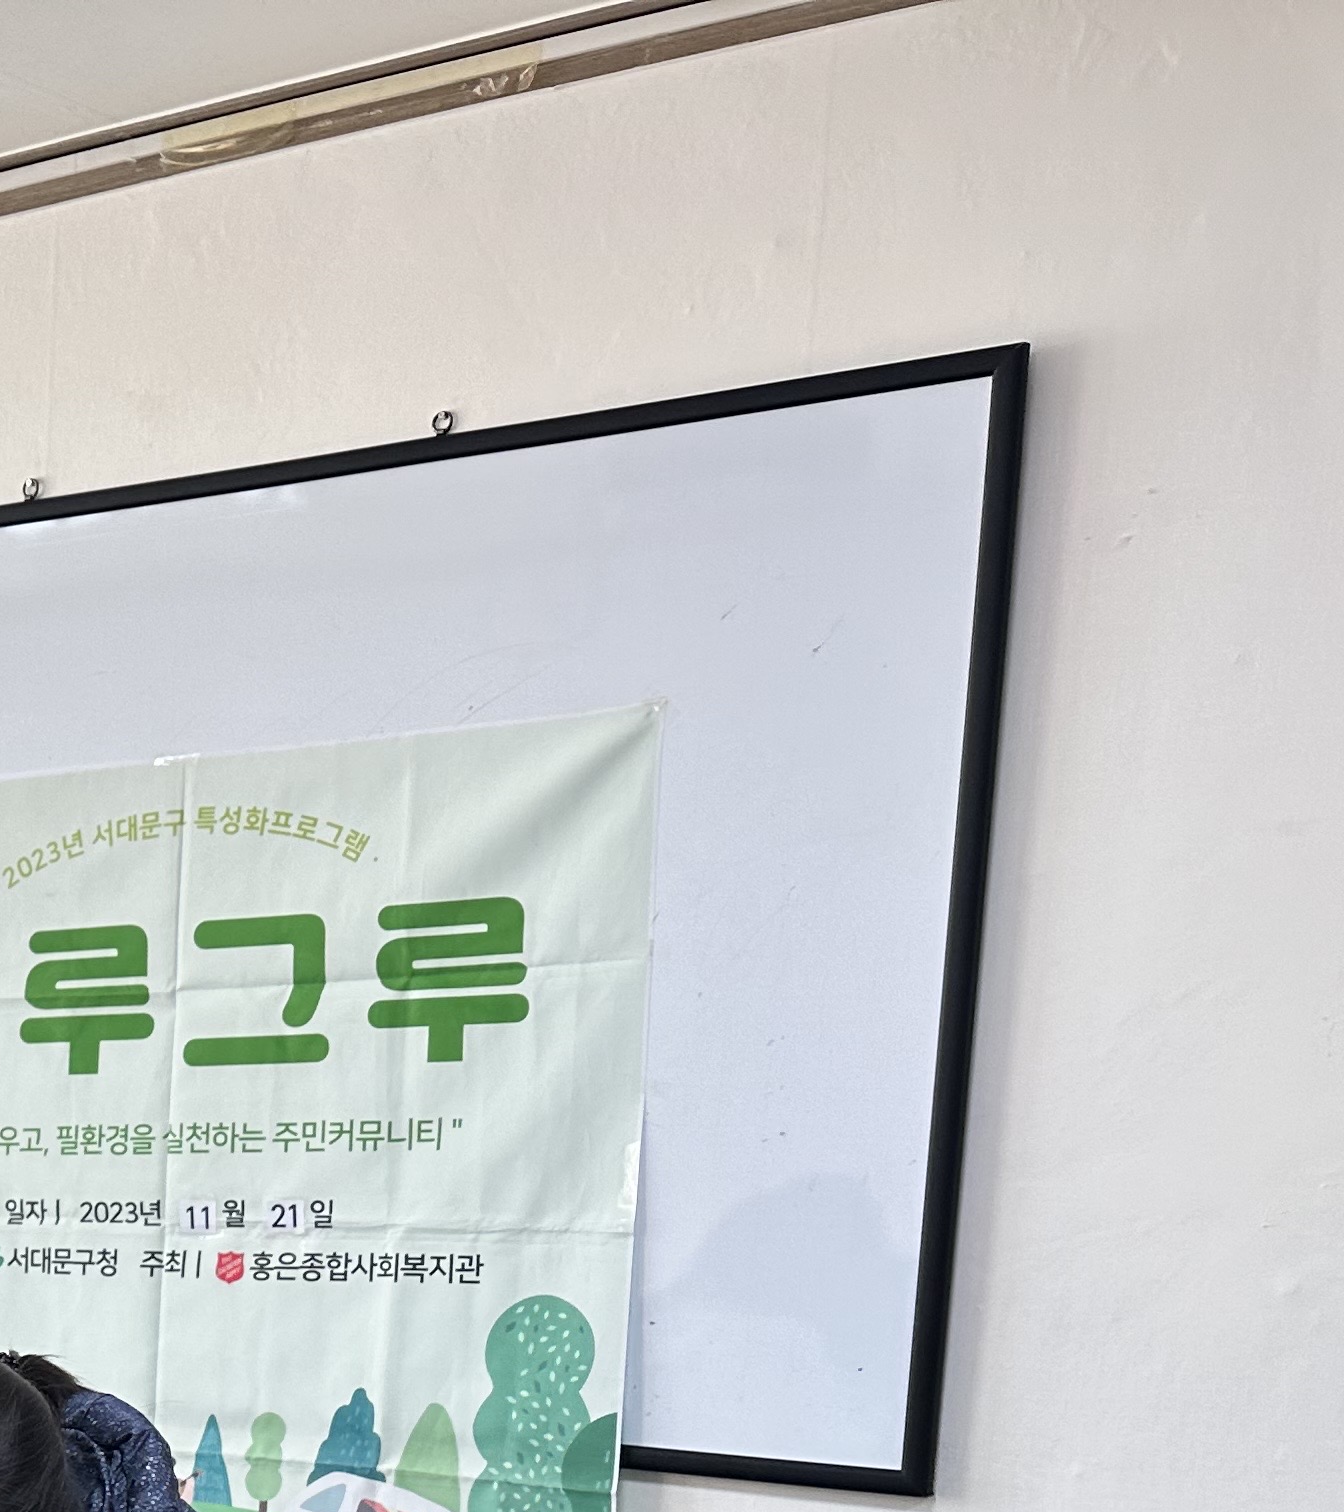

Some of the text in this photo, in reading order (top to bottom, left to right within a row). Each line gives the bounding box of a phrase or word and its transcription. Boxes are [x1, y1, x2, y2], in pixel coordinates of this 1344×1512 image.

[2, 805, 371, 889] 2023년 서대문구 특성화프로그램
[56, 1123, 156, 1156] 필환경을
[162, 1122, 267, 1155] 실천하는
[80, 1199, 162, 1227] 2023년
[7, 1246, 119, 1277] 서대문구청
[249, 1250, 485, 1284] 홍은종합사회복지관
